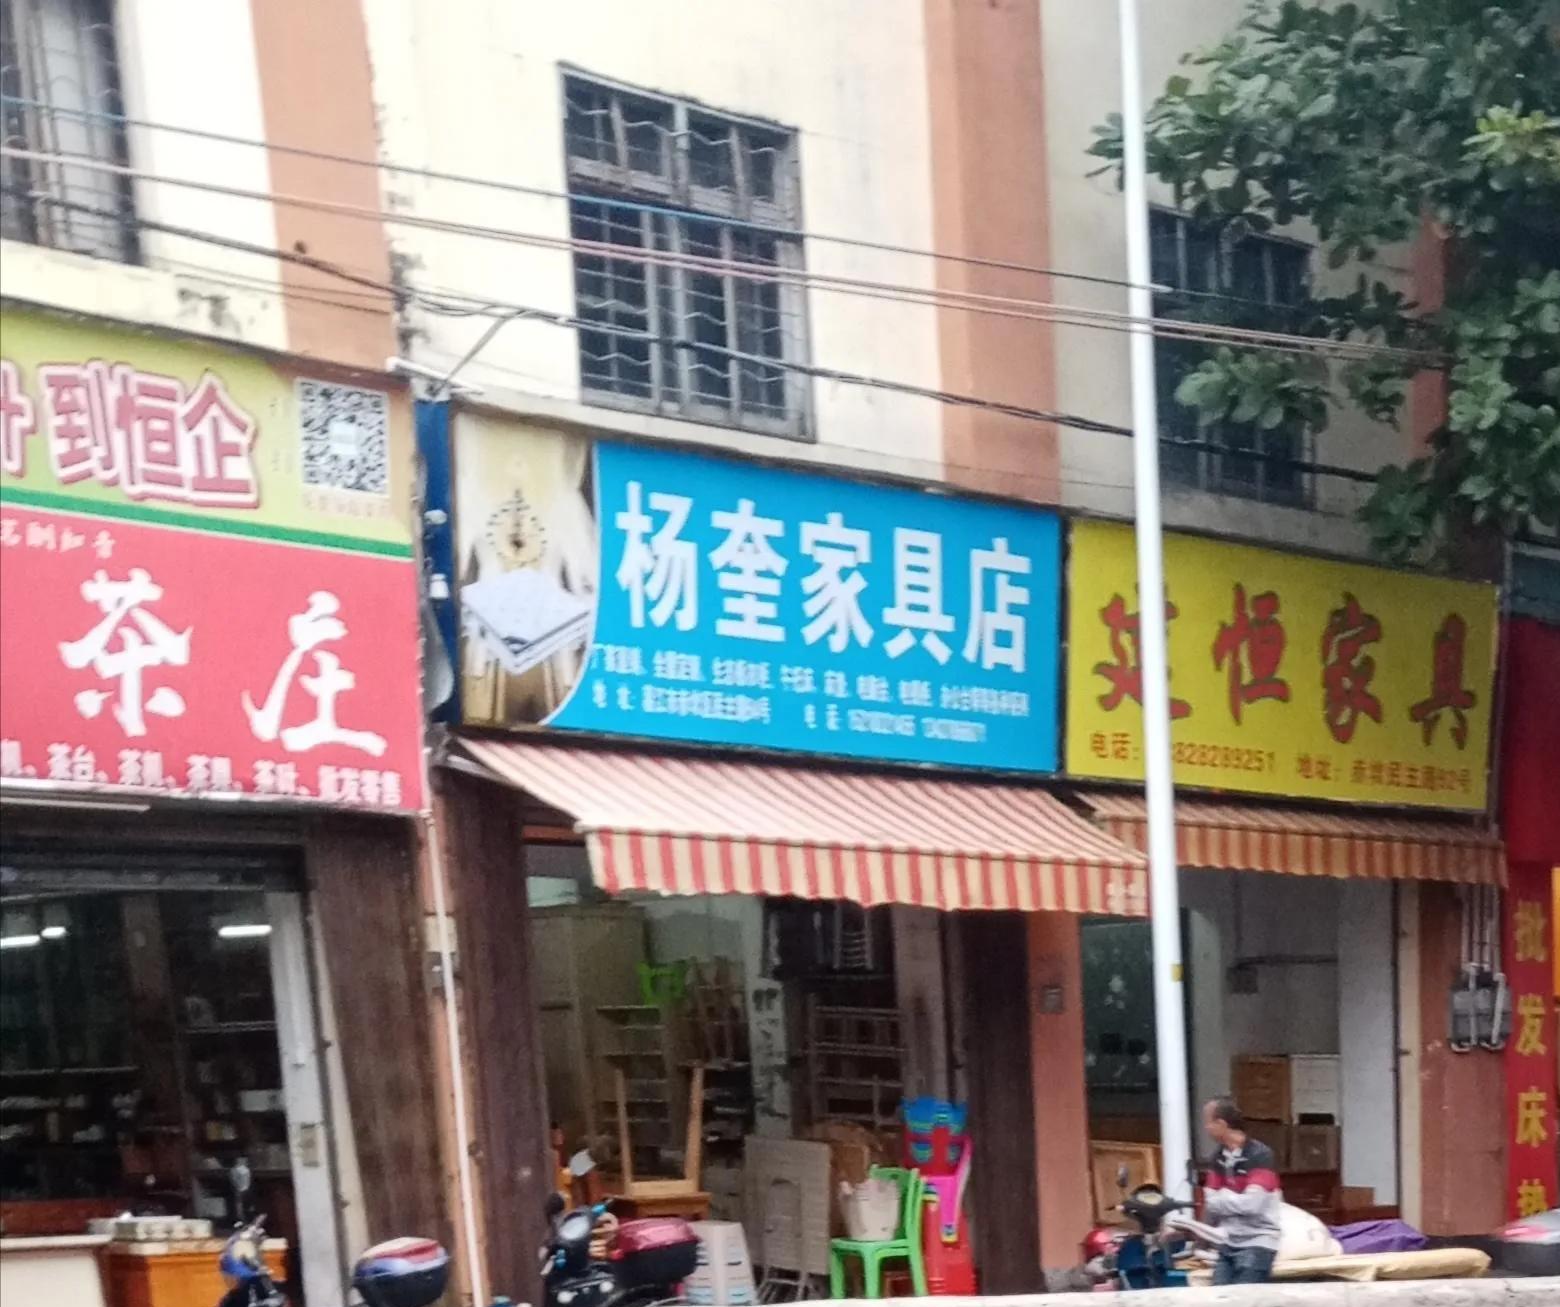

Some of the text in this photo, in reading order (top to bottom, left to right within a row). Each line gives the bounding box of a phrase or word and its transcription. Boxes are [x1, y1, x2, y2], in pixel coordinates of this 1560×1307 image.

[0, 358, 260, 509] 到恒企
[59, 567, 388, 757] 茶庄
[614, 480, 1033, 674] 杨奎家具店
